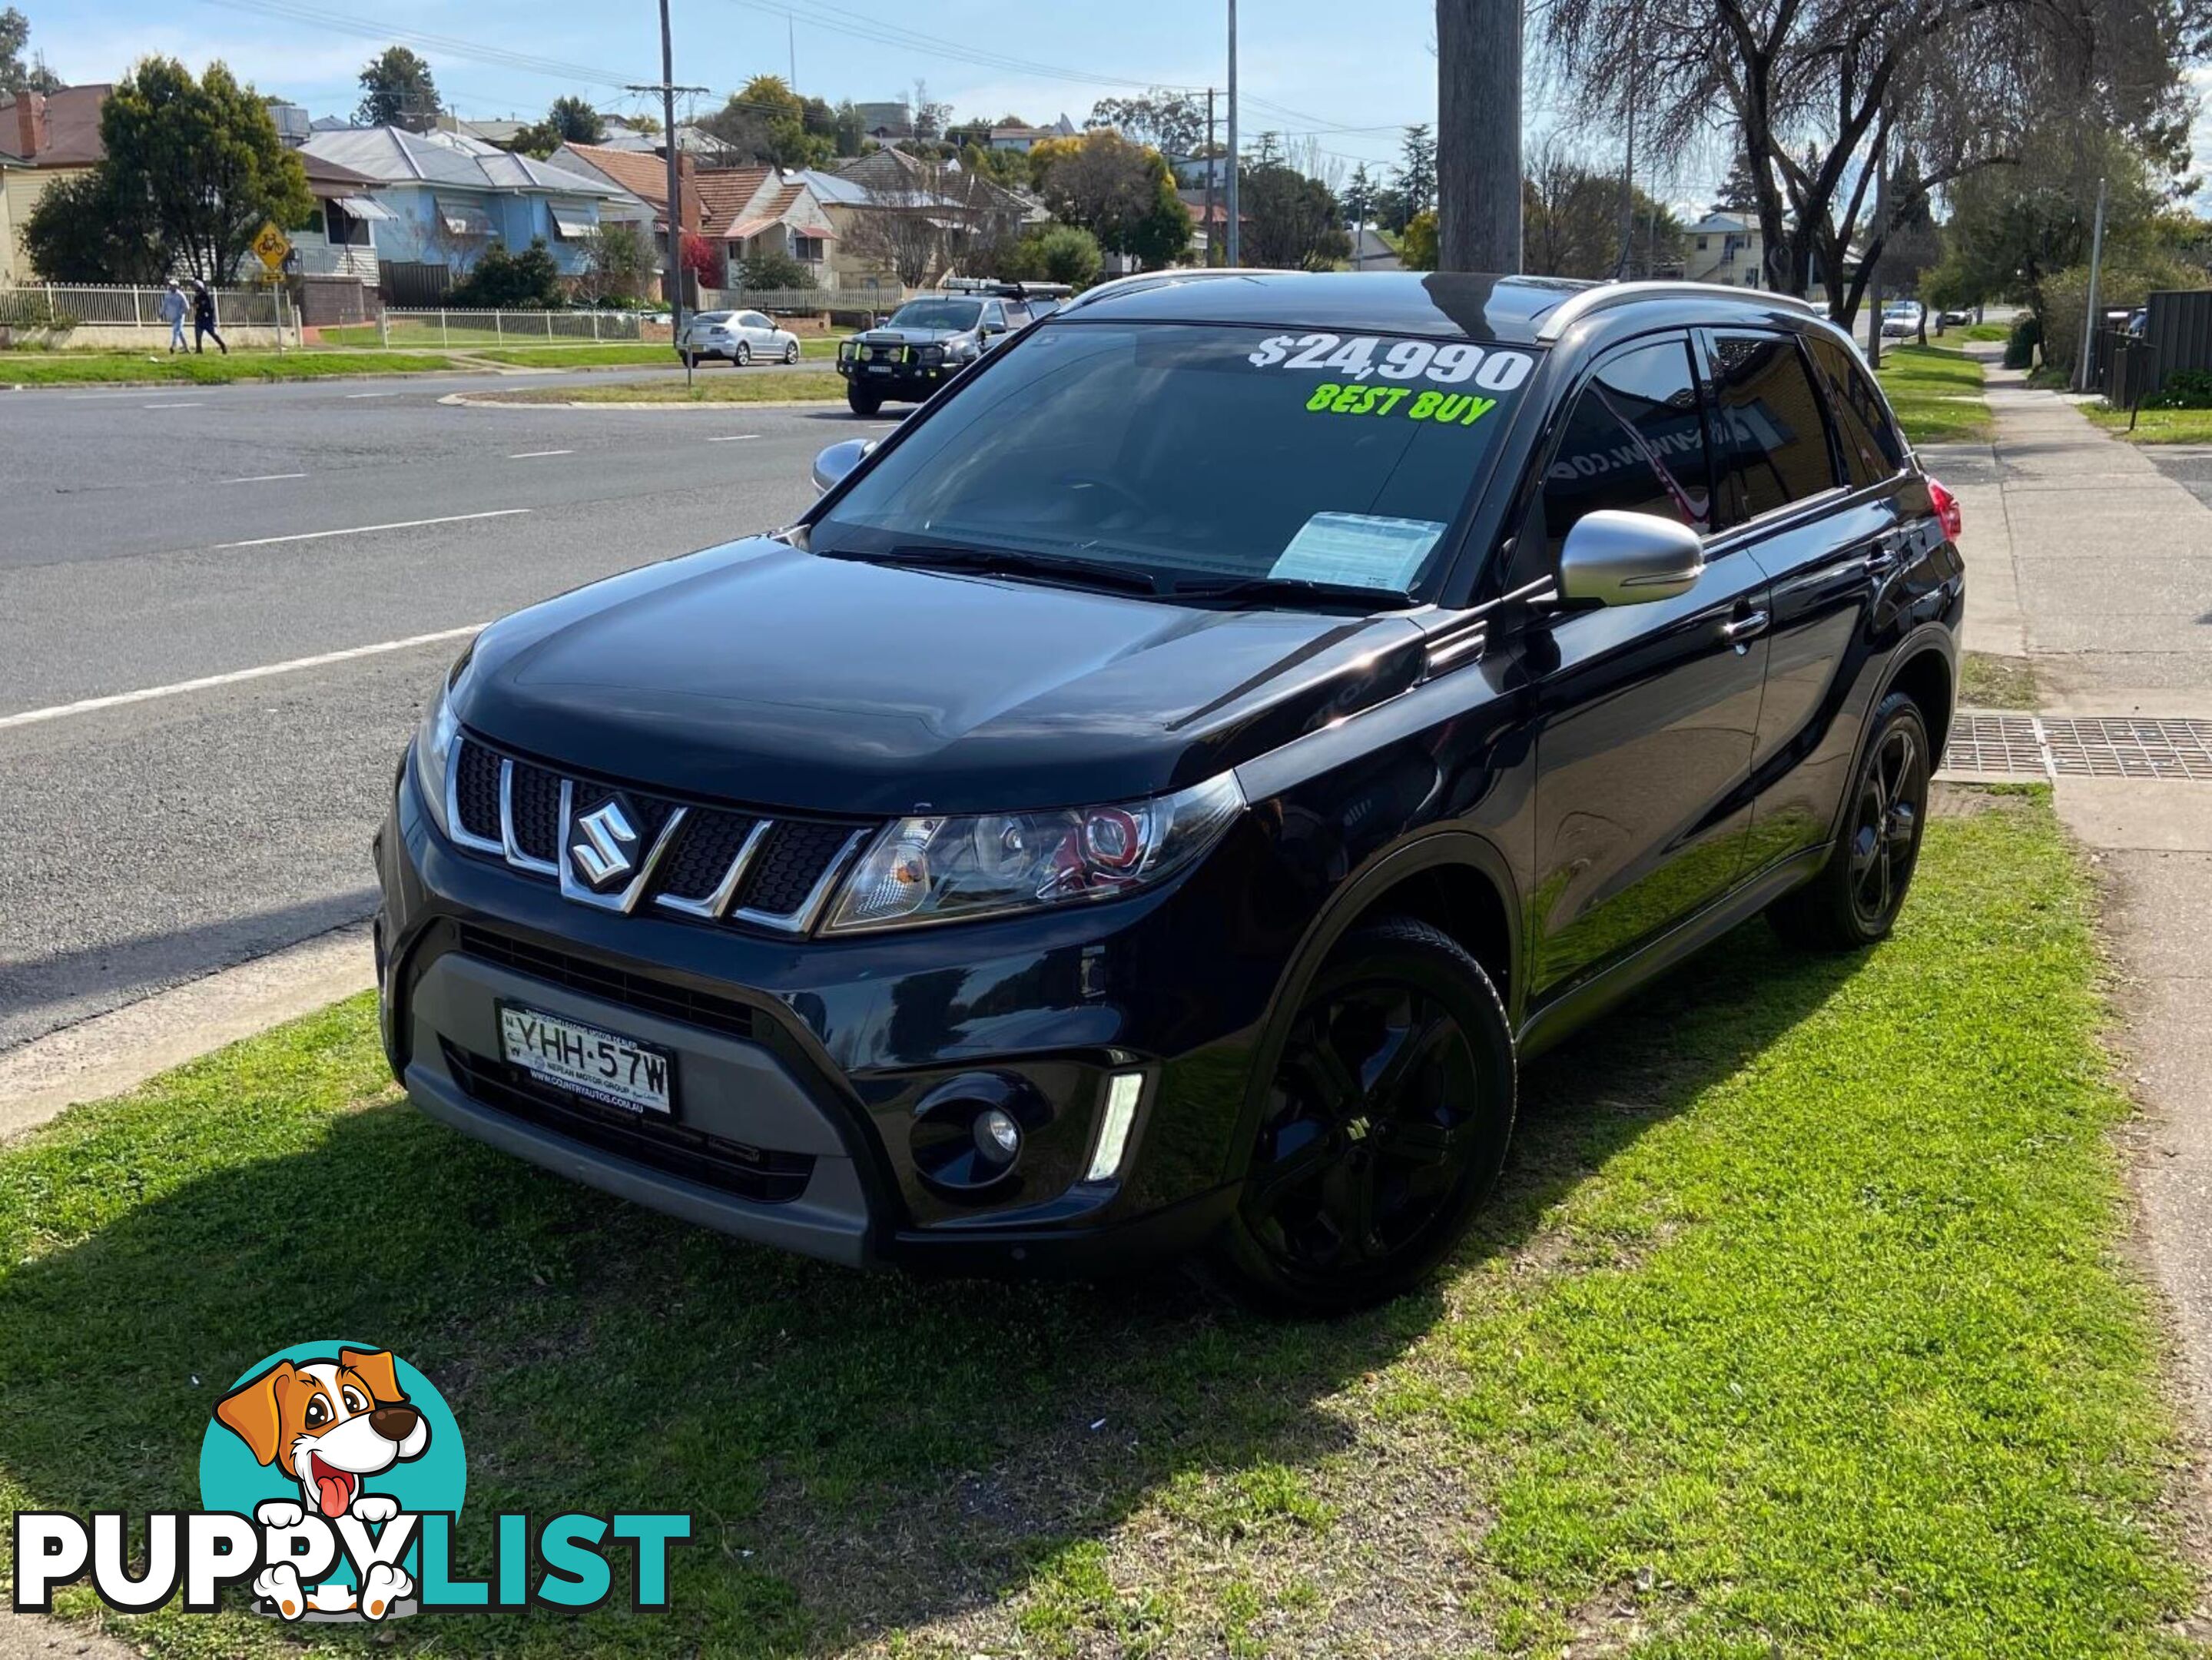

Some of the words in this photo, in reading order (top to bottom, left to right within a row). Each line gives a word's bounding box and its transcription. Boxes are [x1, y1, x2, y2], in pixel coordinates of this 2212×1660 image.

[1248, 334, 1534, 391] $24,990
[1306, 383, 1411, 415] BEST
[1408, 390, 1497, 426] BUY
[575, 1071, 603, 1086] MOTOR
[604, 1080, 630, 1094] GROUP
